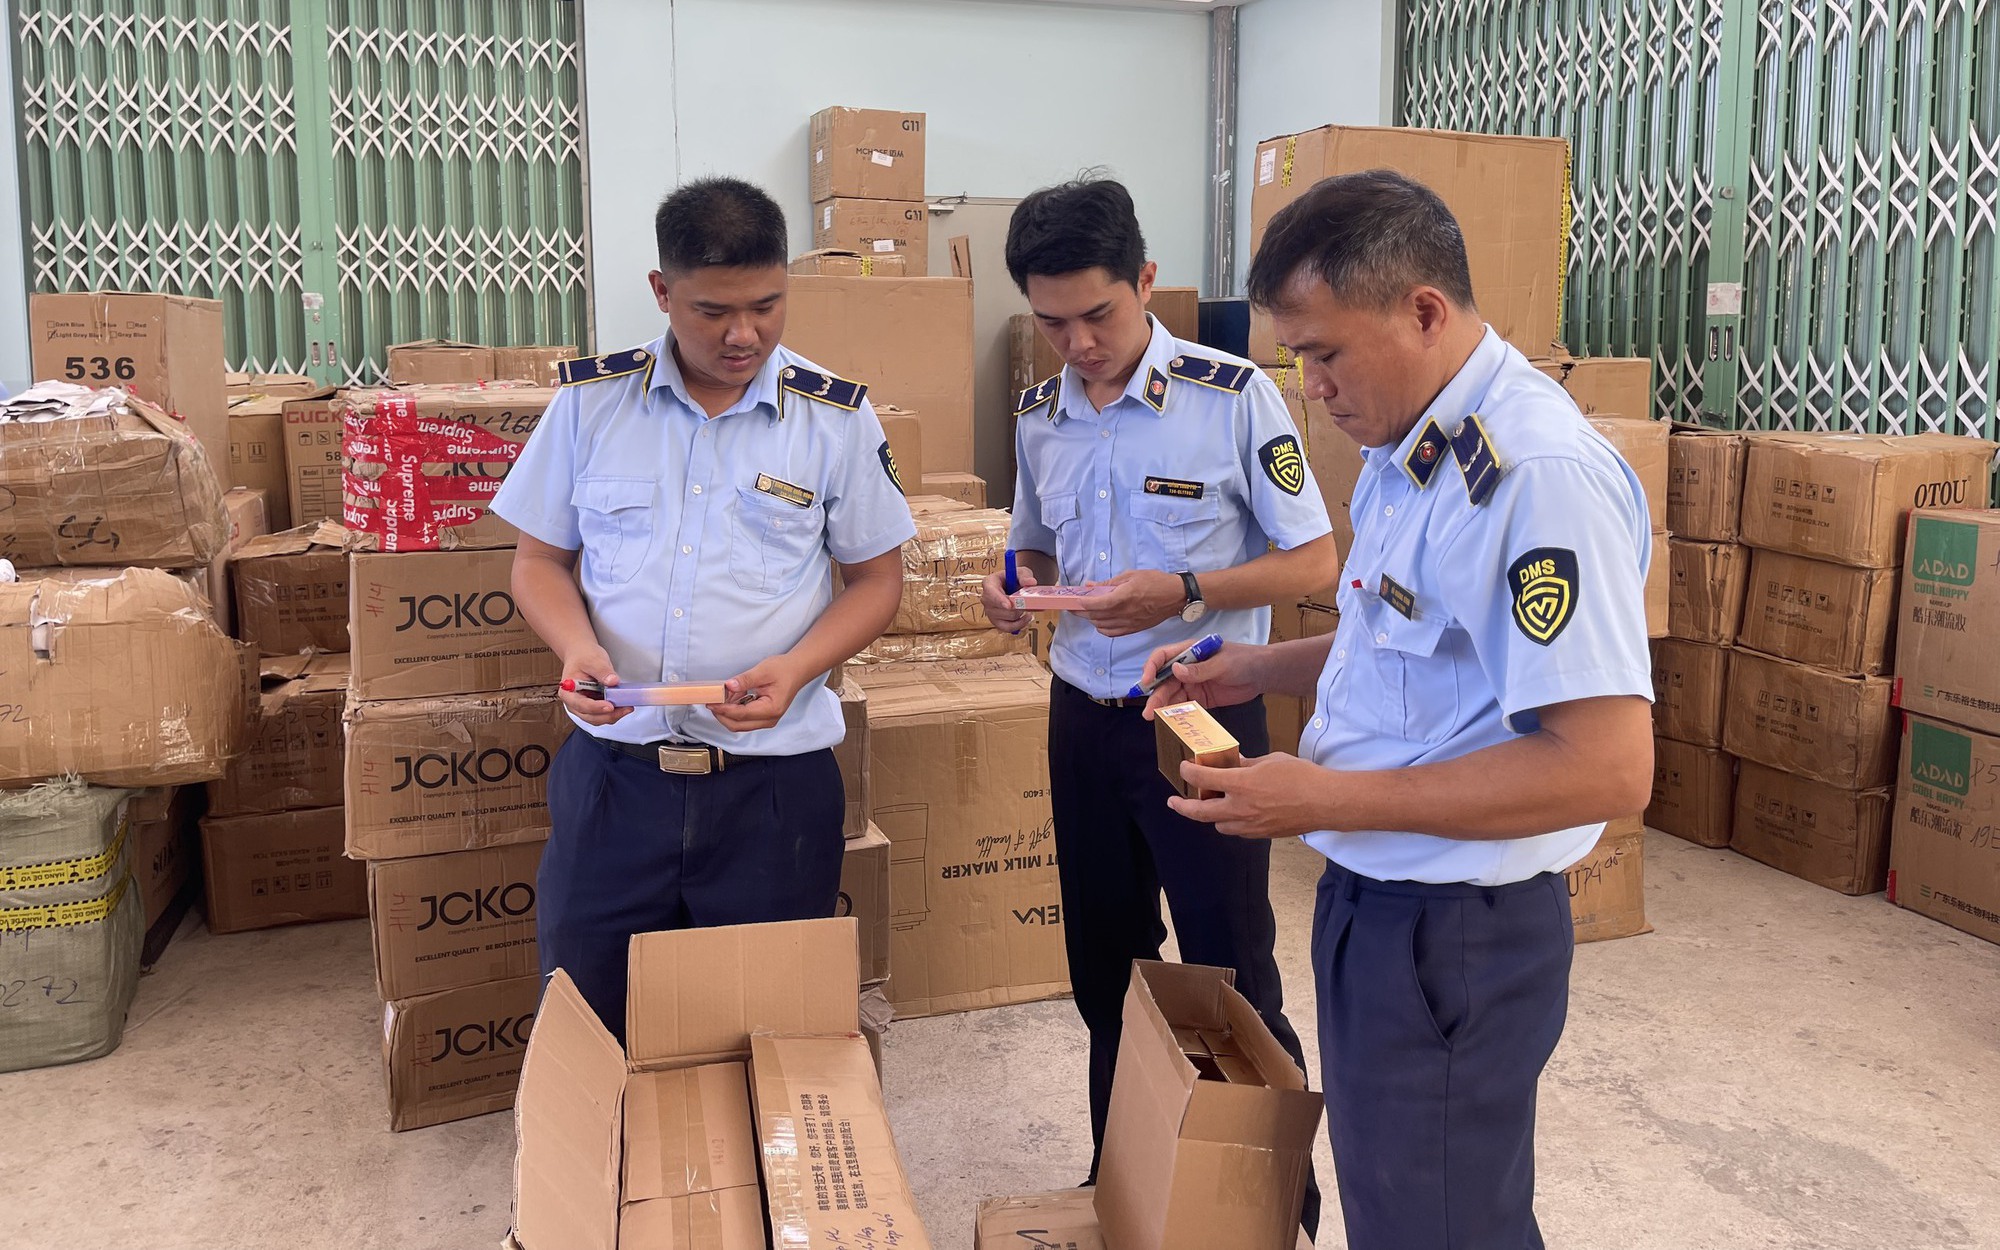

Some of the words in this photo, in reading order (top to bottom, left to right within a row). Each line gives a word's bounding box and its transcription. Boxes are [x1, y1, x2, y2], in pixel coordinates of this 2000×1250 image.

[902, 120, 920, 132] G11
[904, 210, 922, 221] G11
[56, 331, 72, 339] Light
[65, 356, 136, 380] 536
[417, 421, 475, 444] Suprem
[1272, 441, 1294, 457] DMS
[401, 454, 418, 522] Supreme
[1914, 479, 1967, 509] OTOU
[432, 504, 477, 521] Supre
[382, 499, 398, 552] Suprem
[1519, 559, 1556, 585] DMS
[1918, 558, 1969, 580] ADAD
[1914, 582, 1937, 596] COOL
[1939, 585, 1969, 601] HAPPY
[396, 591, 527, 632] JCKO
[394, 656, 430, 665] EXCELLENT
[431, 653, 460, 661] QUALITY
[474, 651, 492, 659] BOLD
[501, 648, 529, 656] SCALING
[391, 744, 550, 792] JCKOO
[1916, 761, 1964, 788] ADAD
[1023, 789, 1044, 799] E400
[1912, 783, 1933, 799] COOL
[1936, 791, 1965, 809] HAPPY
[389, 815, 426, 824] EXCELLENT
[427, 812, 456, 821] QUALITY
[498, 804, 526, 812] SCALING
[1013, 829, 1025, 850] of
[1029, 817, 1054, 852] gift
[975, 834, 1011, 858] health
[942, 860, 998, 879] MAKER
[1003, 855, 1041, 871] MILK
[417, 882, 536, 931] JCKO
[1012, 904, 1062, 926] EKA
[415, 951, 450, 963] EXCELLENT
[452, 946, 480, 957] QUALITY
[494, 941, 512, 949] BOLD
[521, 937, 537, 945] SCAL
[428, 1080, 462, 1091] EXCELLENT
[464, 1074, 491, 1085] QUALITY
